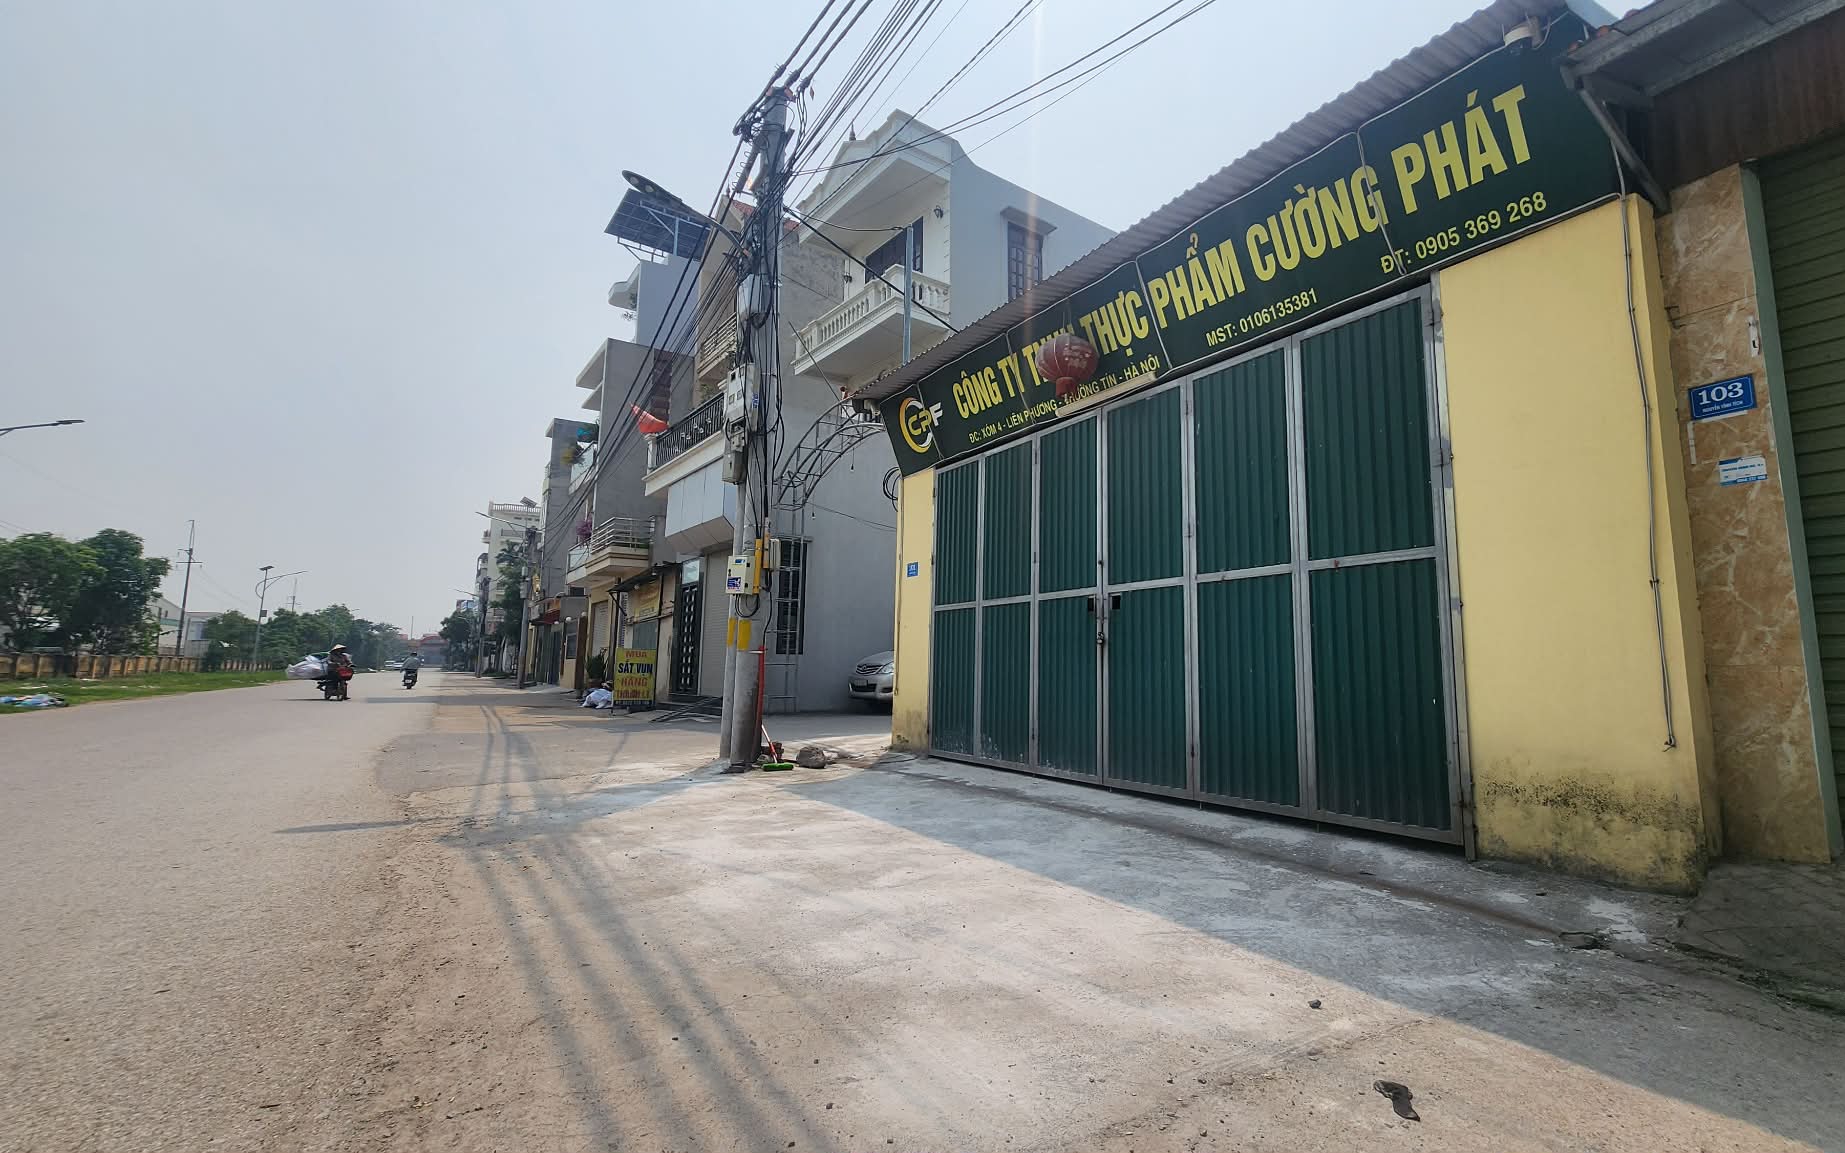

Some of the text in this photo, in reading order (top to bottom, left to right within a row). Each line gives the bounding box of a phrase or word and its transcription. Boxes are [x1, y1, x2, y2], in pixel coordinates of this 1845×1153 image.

[953, 367, 1003, 419] CÔNG
[997, 352, 1025, 398] TY
[1079, 290, 1149, 357] THỰC
[1147, 232, 1245, 329] PHẨM
[1245, 165, 1389, 282] CƯỜNG
[1391, 84, 1532, 214] PHÁT
[1380, 191, 1547, 273] ĐT: 0905 369 268
[1205, 288, 1318, 347] MST: 0106135381
[907, 402, 943, 436] CPF
[981, 424, 997, 438] XÓM
[1005, 413, 1024, 428] LIÊN
[1023, 399, 1058, 422] PHƯƠNG
[1100, 372, 1117, 390] TÍN
[1123, 361, 1140, 380] HÀ
[1698, 382, 1744, 405] 103
[617, 659, 653, 677] SẮT VỤN
